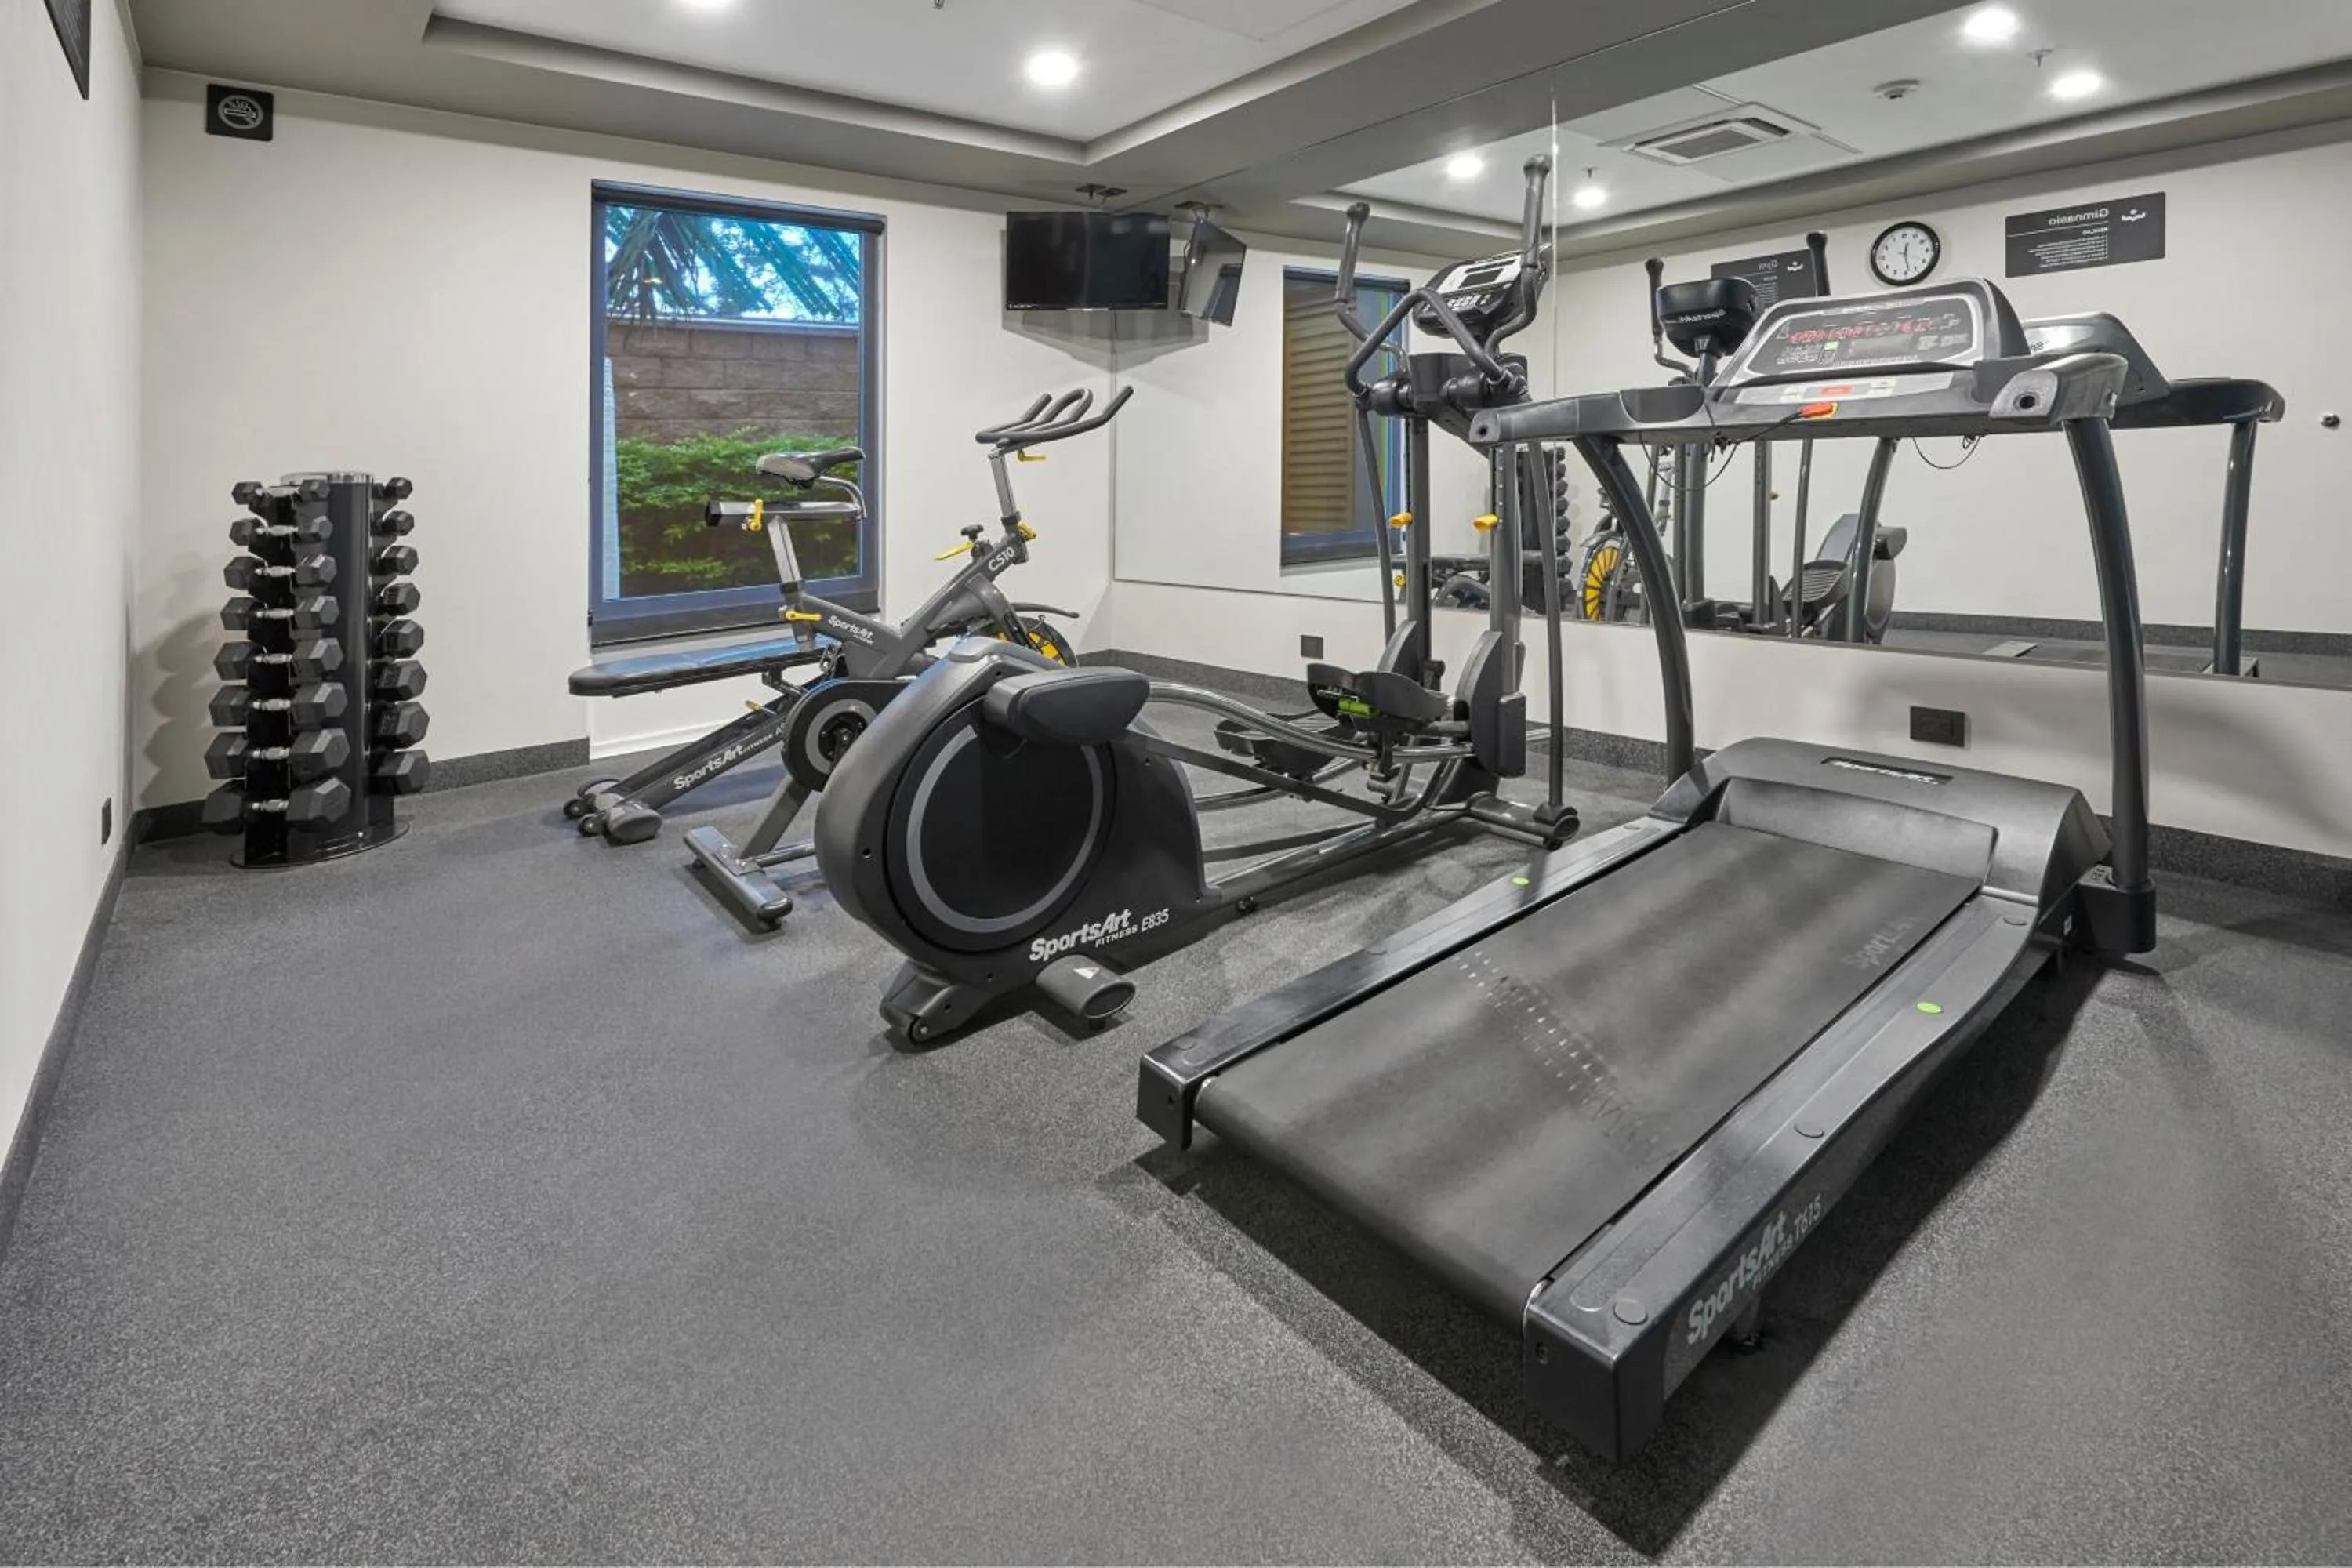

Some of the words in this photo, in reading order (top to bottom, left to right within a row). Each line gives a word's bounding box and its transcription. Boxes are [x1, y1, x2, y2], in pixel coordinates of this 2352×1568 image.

[988, 546, 1015, 572] C510
[828, 615, 873, 639] SportsArt
[673, 745, 743, 790] SportsArt
[1029, 908, 1132, 962] SportsArt
[1094, 924, 1138, 948] FITNESS
[1140, 908, 1170, 933] E835
[1794, 1192, 1823, 1242] T615
[1687, 1210, 1787, 1345] SportsArt
